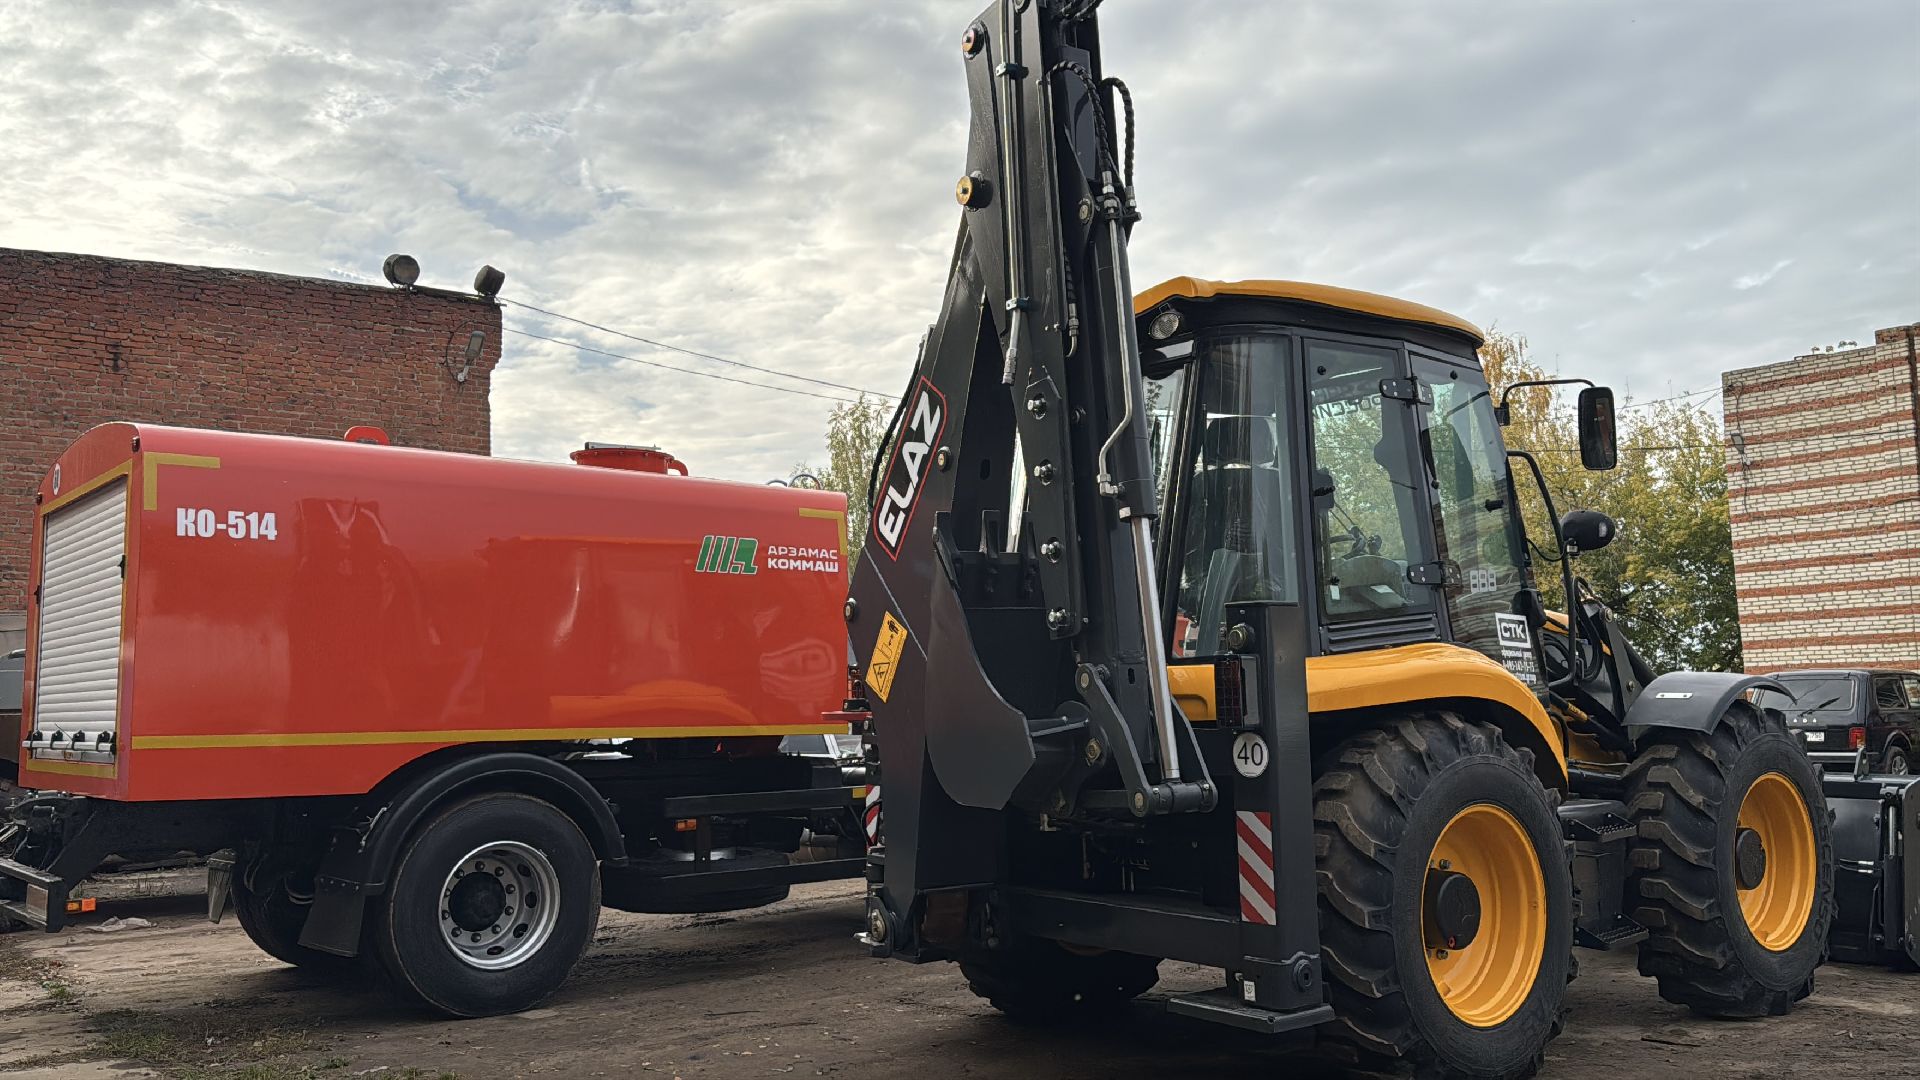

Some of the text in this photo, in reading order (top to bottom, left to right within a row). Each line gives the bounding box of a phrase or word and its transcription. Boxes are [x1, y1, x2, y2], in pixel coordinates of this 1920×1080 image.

[879, 390, 941, 547] ELAZ
[177, 508, 277, 540] КО-514
[768, 545, 838, 559] АРЗАМАС
[768, 557, 839, 573] КОММАШ
[1501, 622, 1525, 638] СТК
[1238, 742, 1263, 766] 40
